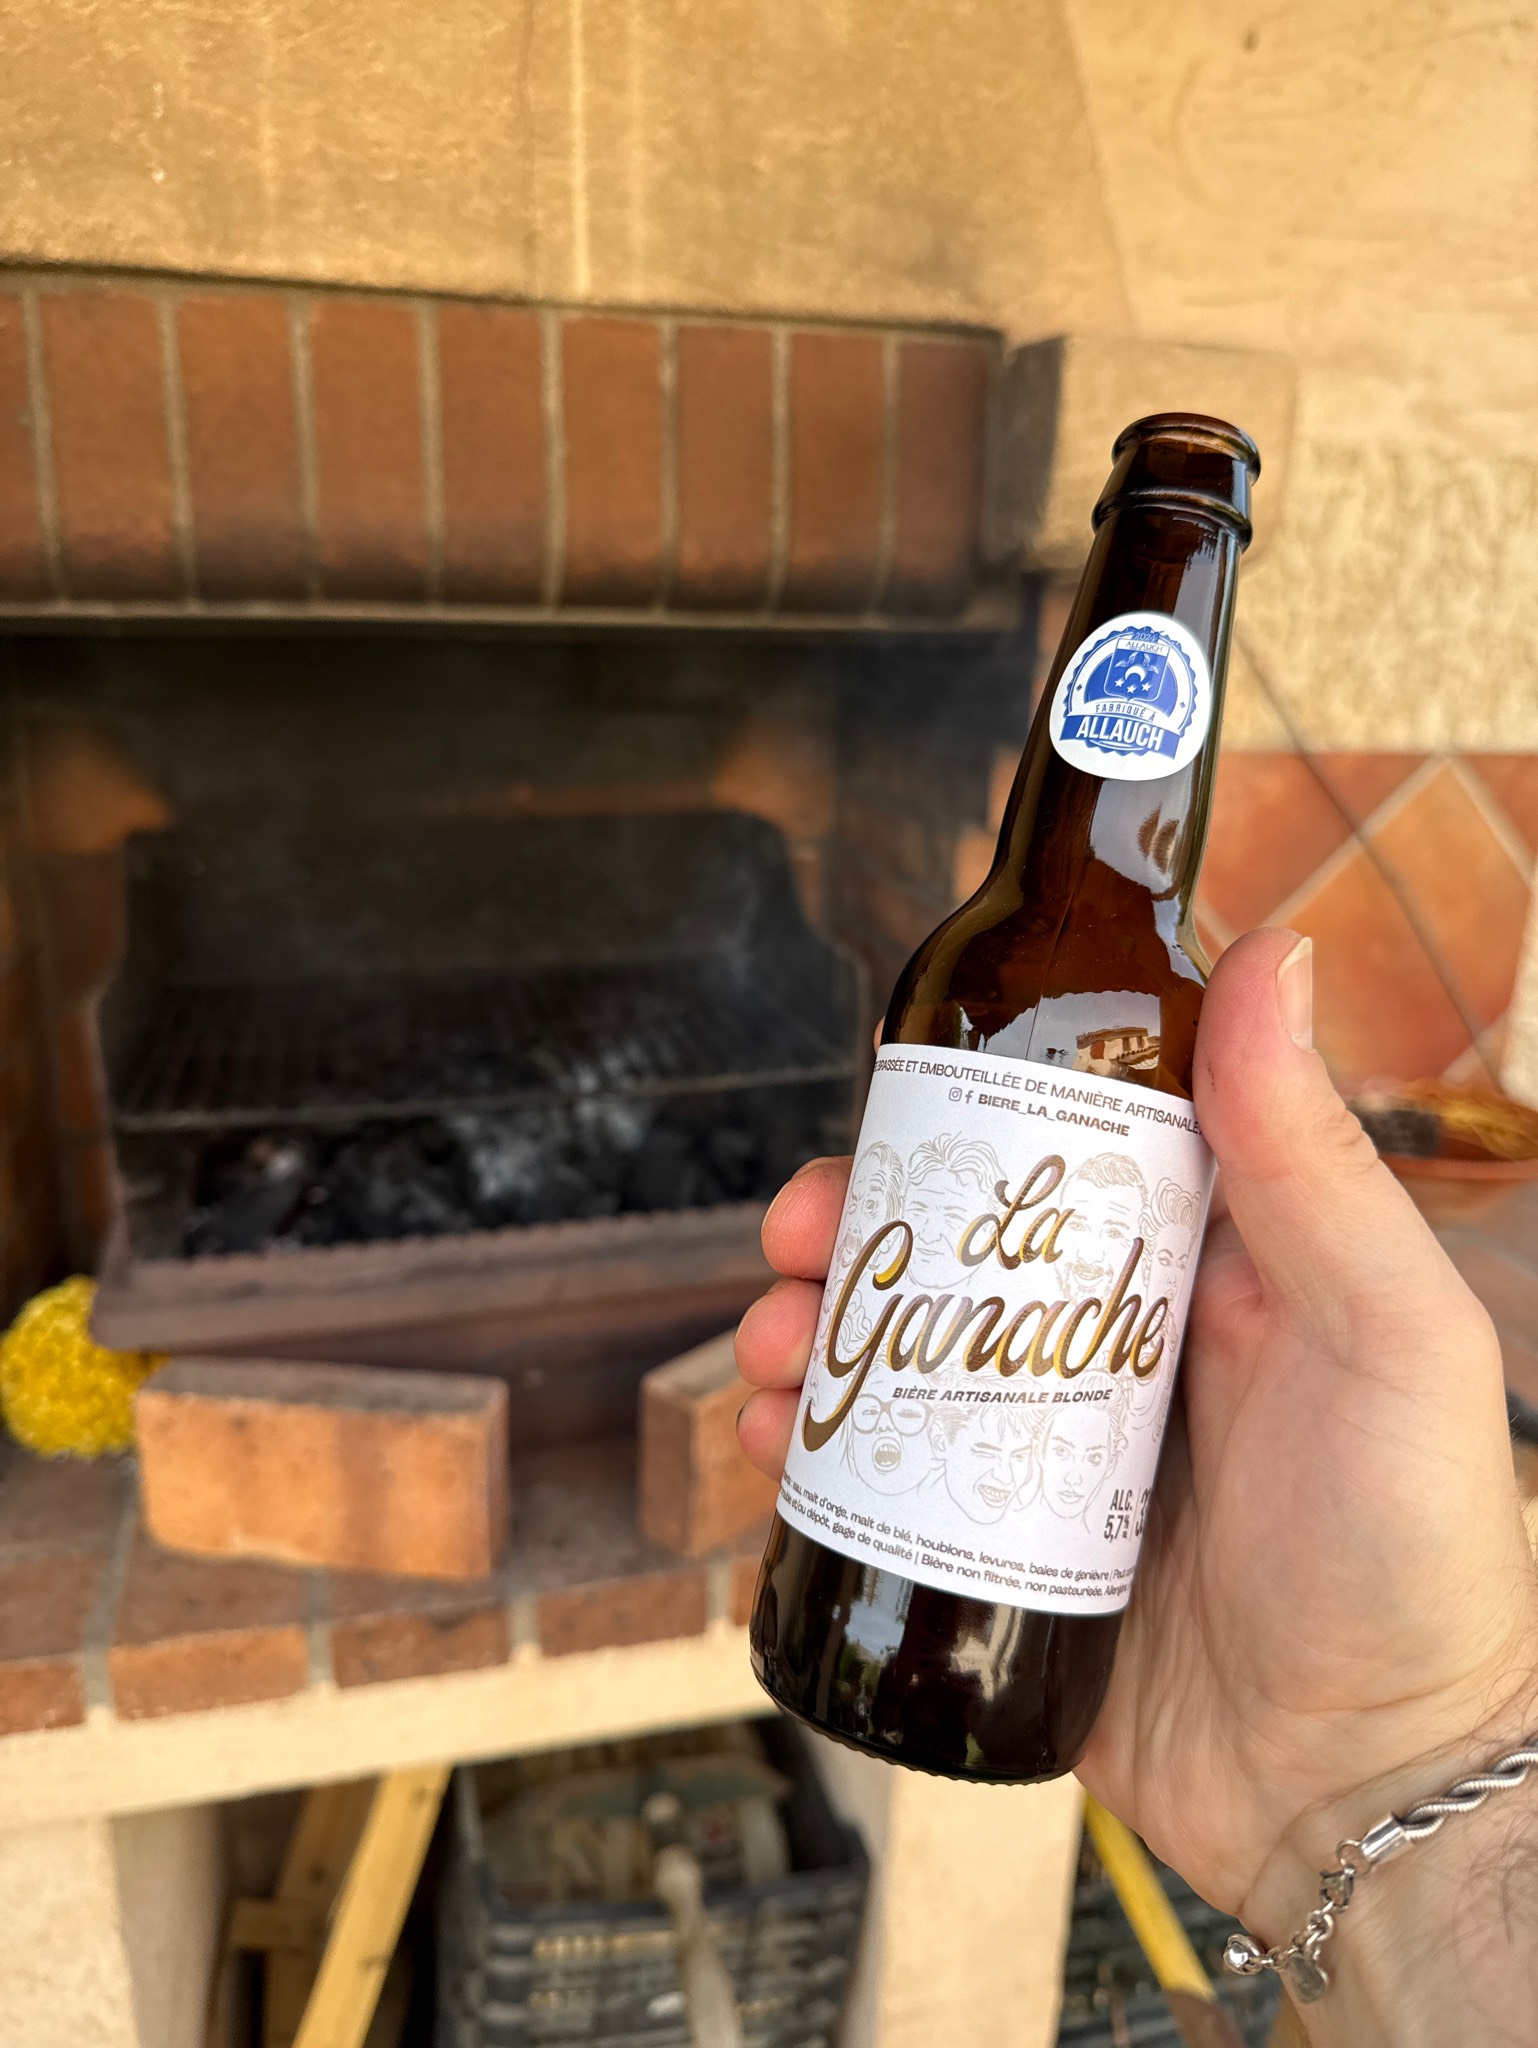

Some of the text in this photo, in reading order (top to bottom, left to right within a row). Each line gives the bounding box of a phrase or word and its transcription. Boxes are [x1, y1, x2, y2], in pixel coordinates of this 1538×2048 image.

[1126, 641, 1163, 652] ALLAUCH
[1076, 716, 1164, 751] ALLAUCH
[905, 1060, 919, 1073] ET
[919, 1061, 1022, 1090] EMBOUTEILLÉE
[1024, 1079, 1048, 1095] DE
[1050, 1084, 1123, 1112] MANIÈRE
[1124, 1102, 1199, 1135] ARTISANALE
[978, 1093, 1130, 1137] BIERE_LA_GANACHE
[957, 1154, 1076, 1270] La
[802, 1220, 1169, 1452] Ganache
[892, 1386, 1113, 1404] BIÈRE ARTISANALE BLONDE
[1109, 1489, 1133, 1511] ALC.
[803, 1489, 819, 1504] malt
[819, 1497, 848, 1519] d'orge,
[850, 1512, 874, 1529] malt
[876, 1522, 891, 1535] de
[893, 1526, 913, 1544] blé,
[916, 1534, 976, 1562] houblons,
[979, 1552, 1026, 1573] levures,
[1029, 1562, 1059, 1577] baies
[1060, 1567, 1073, 1579] de
[807, 1508, 830, 1529] dépôt,
[832, 1522, 856, 1539] gage
[857, 1532, 871, 1545] de
[873, 1539, 913, 1560] qualité
[921, 1553, 954, 1573] Bière
[956, 1566, 981, 1580] non
[983, 1570, 1021, 1589] filtrée,
[1025, 1581, 1047, 1593] non
